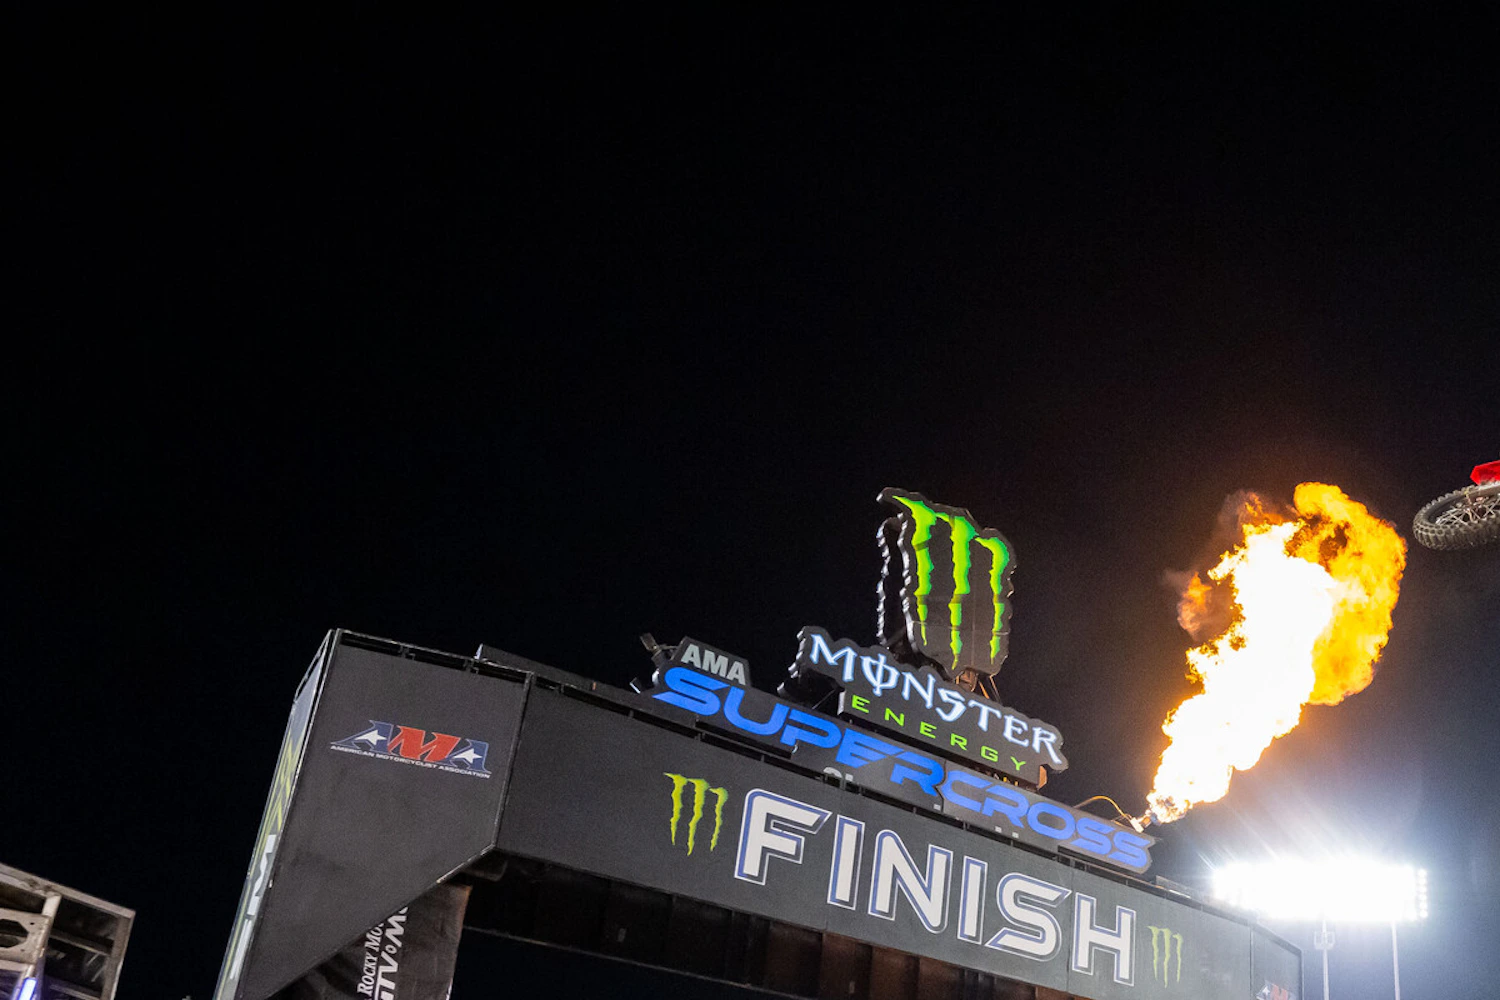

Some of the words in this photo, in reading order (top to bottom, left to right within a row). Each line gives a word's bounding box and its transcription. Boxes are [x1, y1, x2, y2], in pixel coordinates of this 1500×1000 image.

[681, 643, 746, 687] AMA
[809, 633, 1063, 765] MONSTER
[330, 719, 493, 774] AMA
[330, 745, 375, 758] AMERICAN
[376, 753, 437, 769] MOTORCYCLIST
[438, 765, 491, 779] ASSOCIATION
[852, 694, 1027, 772] ENERGY
[653, 667, 1156, 875] SUPERCROSS
[734, 787, 1137, 988] FINISH
[357, 952, 378, 997] ROCKY
